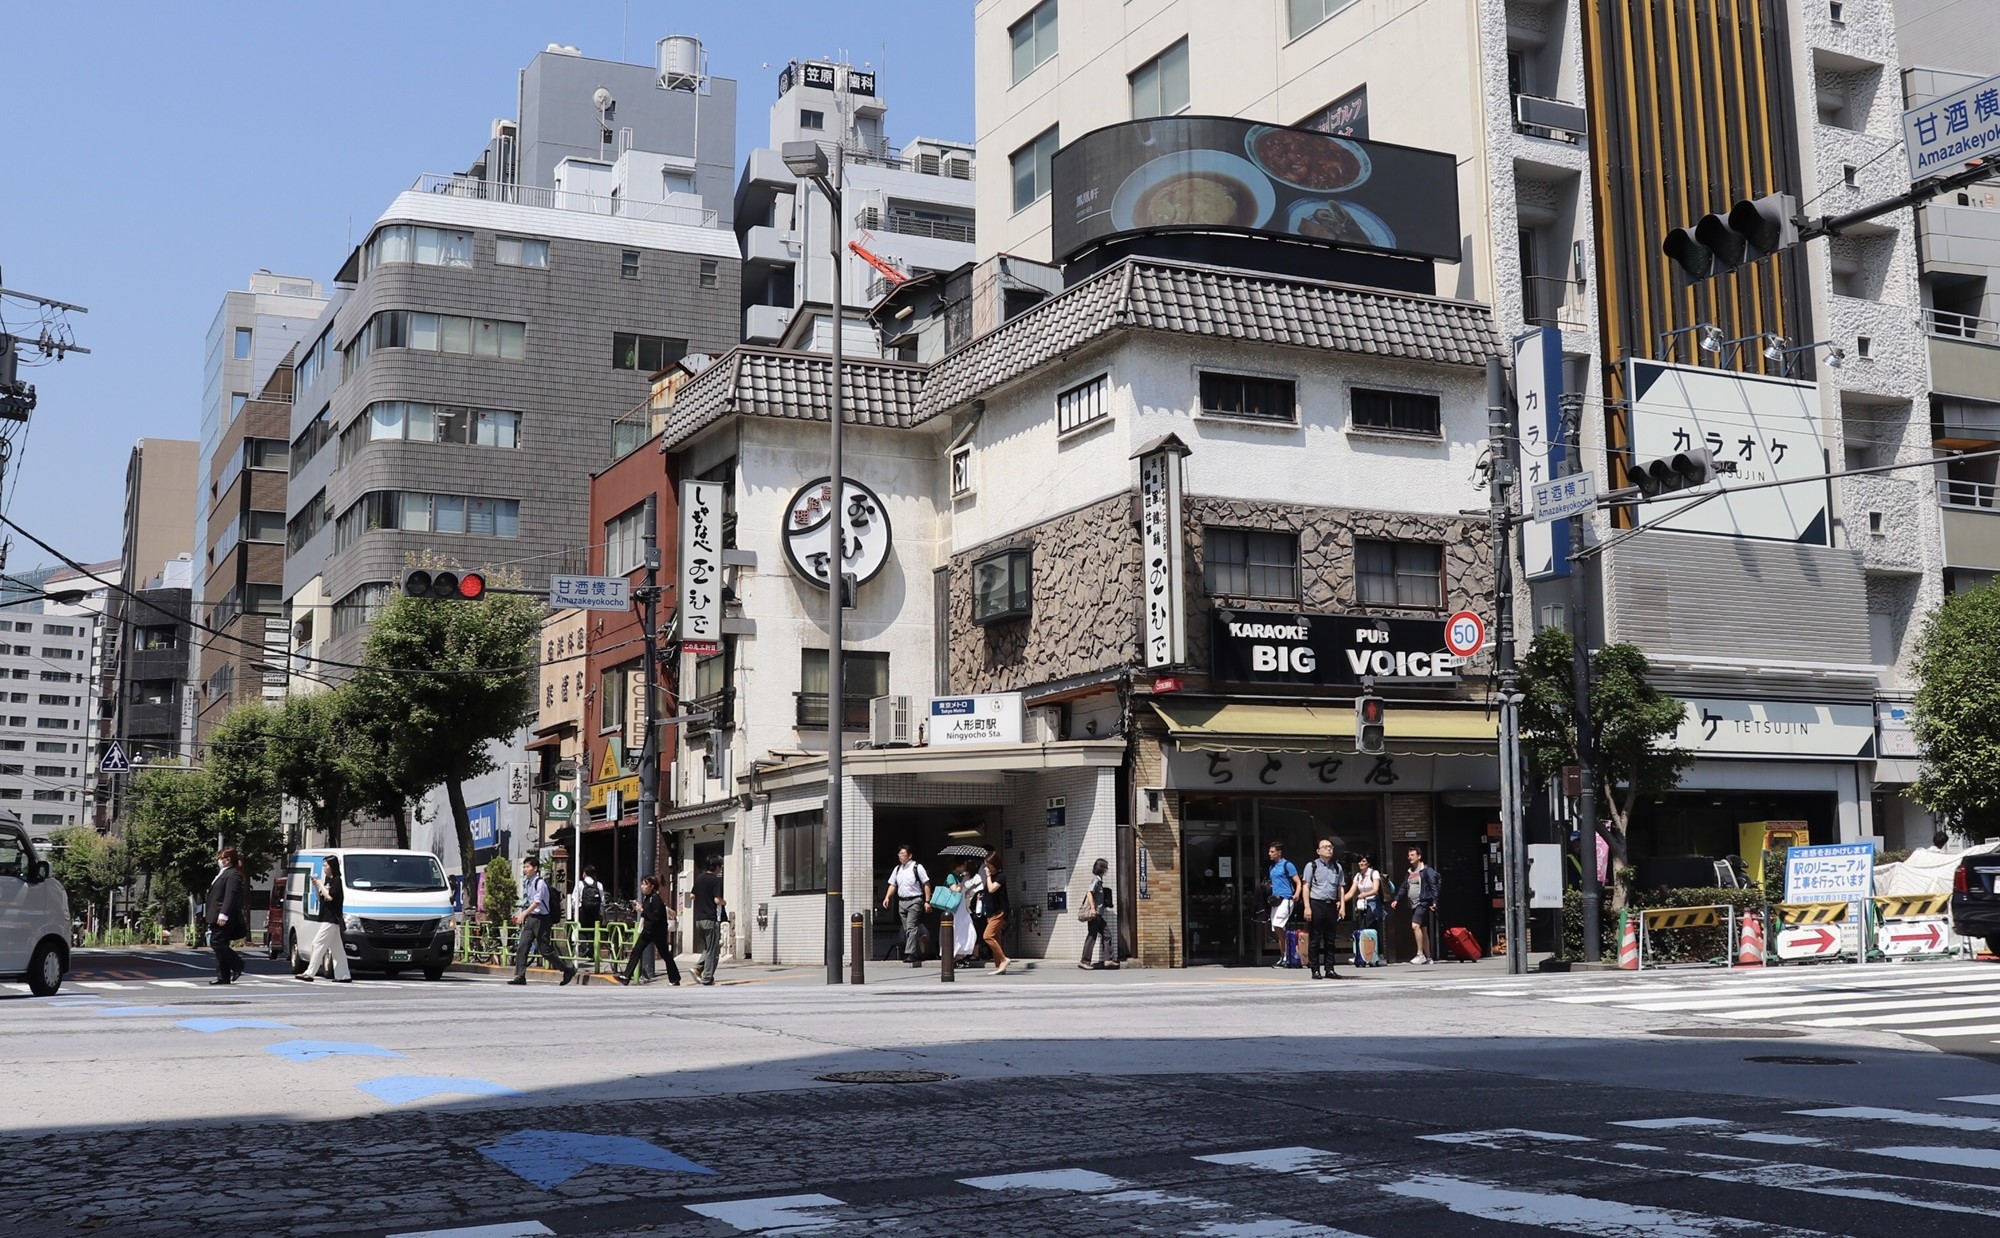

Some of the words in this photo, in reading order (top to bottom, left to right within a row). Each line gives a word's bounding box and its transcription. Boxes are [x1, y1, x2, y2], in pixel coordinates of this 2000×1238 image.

[806, 66, 833, 84] 笠原
[848, 73, 874, 91] 歯科
[1525, 390, 1541, 484] カラオ
[1672, 427, 1788, 464] カラオケ
[1537, 478, 1588, 506] 甘酒横丁
[1538, 498, 1592, 517] Amazakeyokocho
[557, 580, 622, 596] 甘酒横丁
[555, 596, 624, 606] Amazakeyokocho
[1229, 622, 1308, 641] KARAOKE
[1356, 628, 1389, 644] PUB
[1453, 624, 1475, 644] 50
[1252, 645, 1316, 673] BIG
[1345, 649, 1453, 677] VOICE
[939, 701, 967, 709] 東京メトロ
[953, 718, 997, 731] 人形町駅
[1734, 720, 1808, 735] TETSUJIN
[946, 731, 986, 741] Ningyocho
[989, 730, 1003, 738] Sta.
[1206, 751, 1400, 785] ちとせ屋
[470, 814, 491, 841] SEIWA
[1793, 846, 1868, 858] ご迷惑をおかけします
[1794, 859, 1866, 875] 駅のリニューアル
[1793, 874, 1866, 889] 工事を行っています
